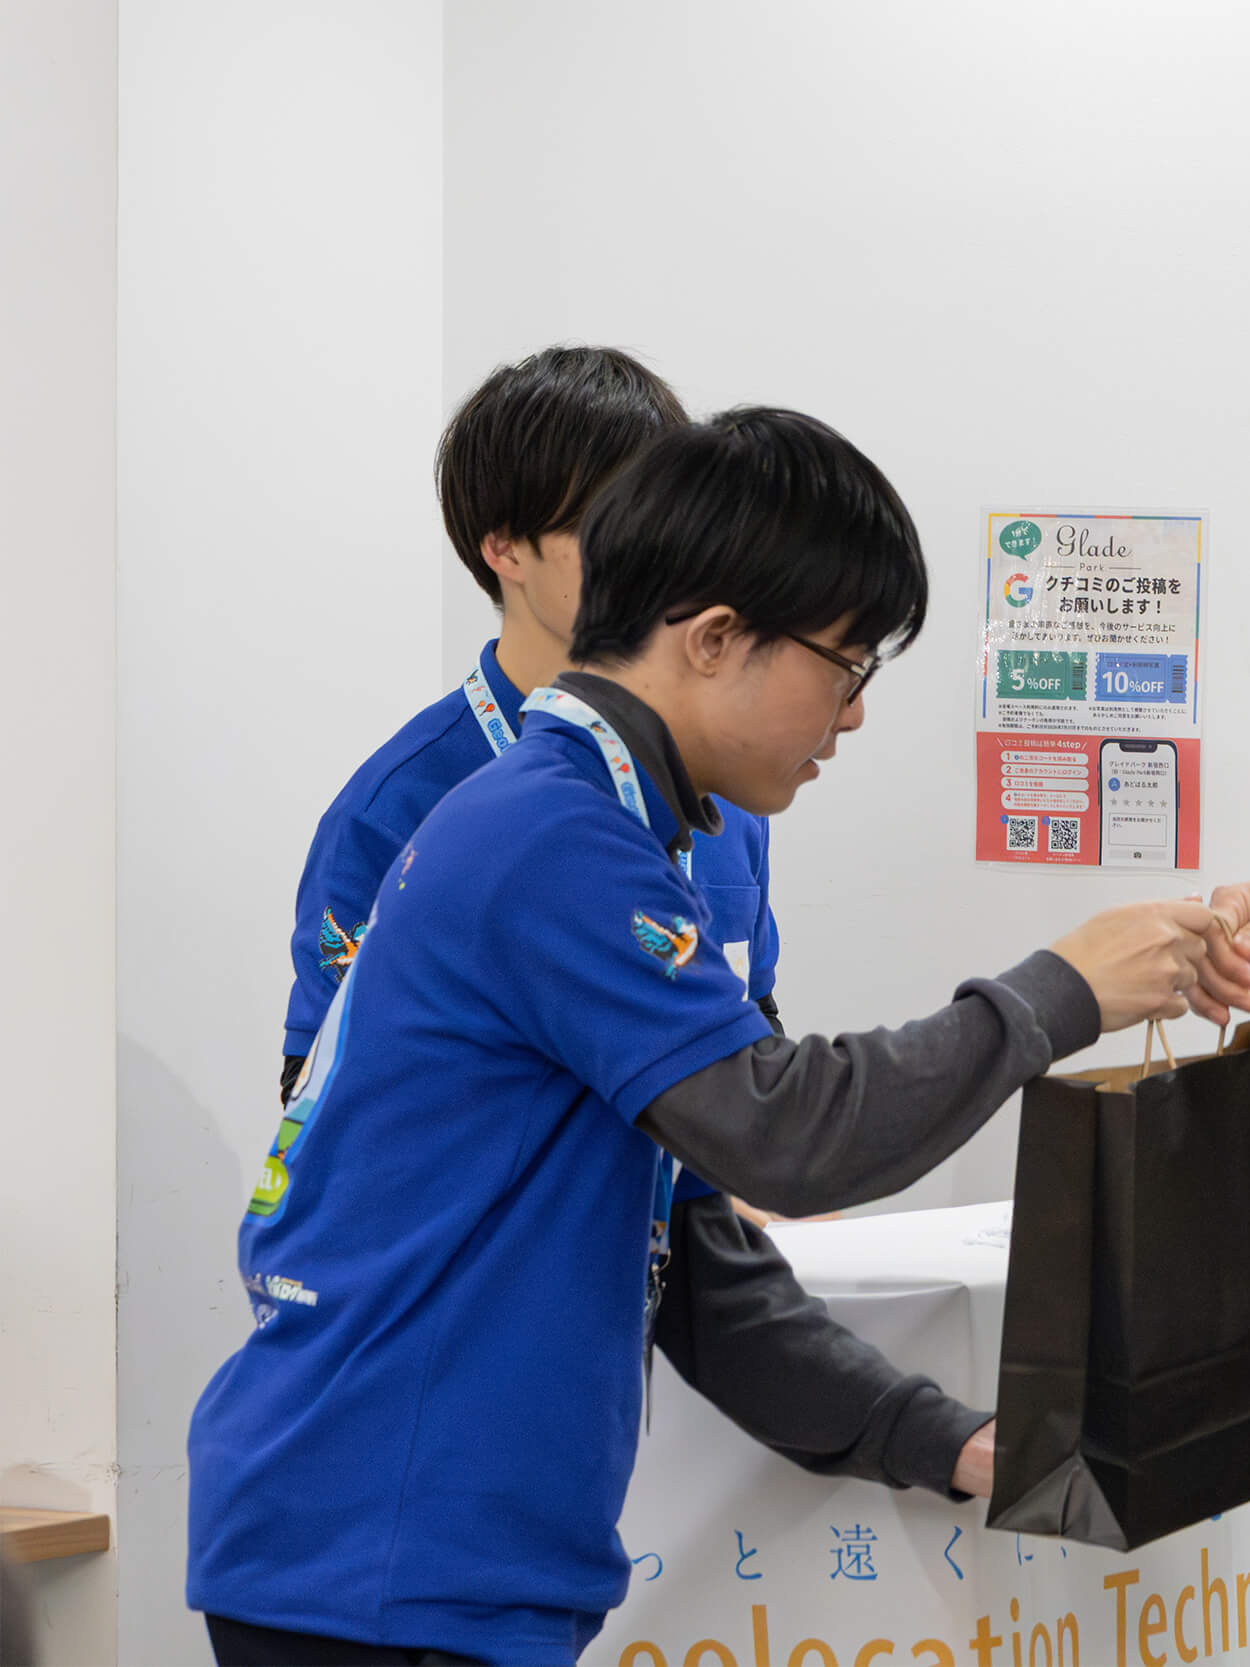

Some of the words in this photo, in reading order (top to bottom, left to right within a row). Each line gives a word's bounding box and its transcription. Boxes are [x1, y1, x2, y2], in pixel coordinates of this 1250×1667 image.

[1056, 525, 1133, 558] Glade
[1079, 563, 1105, 572] Park
[1003, 572, 1034, 608] G
[1045, 575, 1181, 595] クチコミのご投稿を
